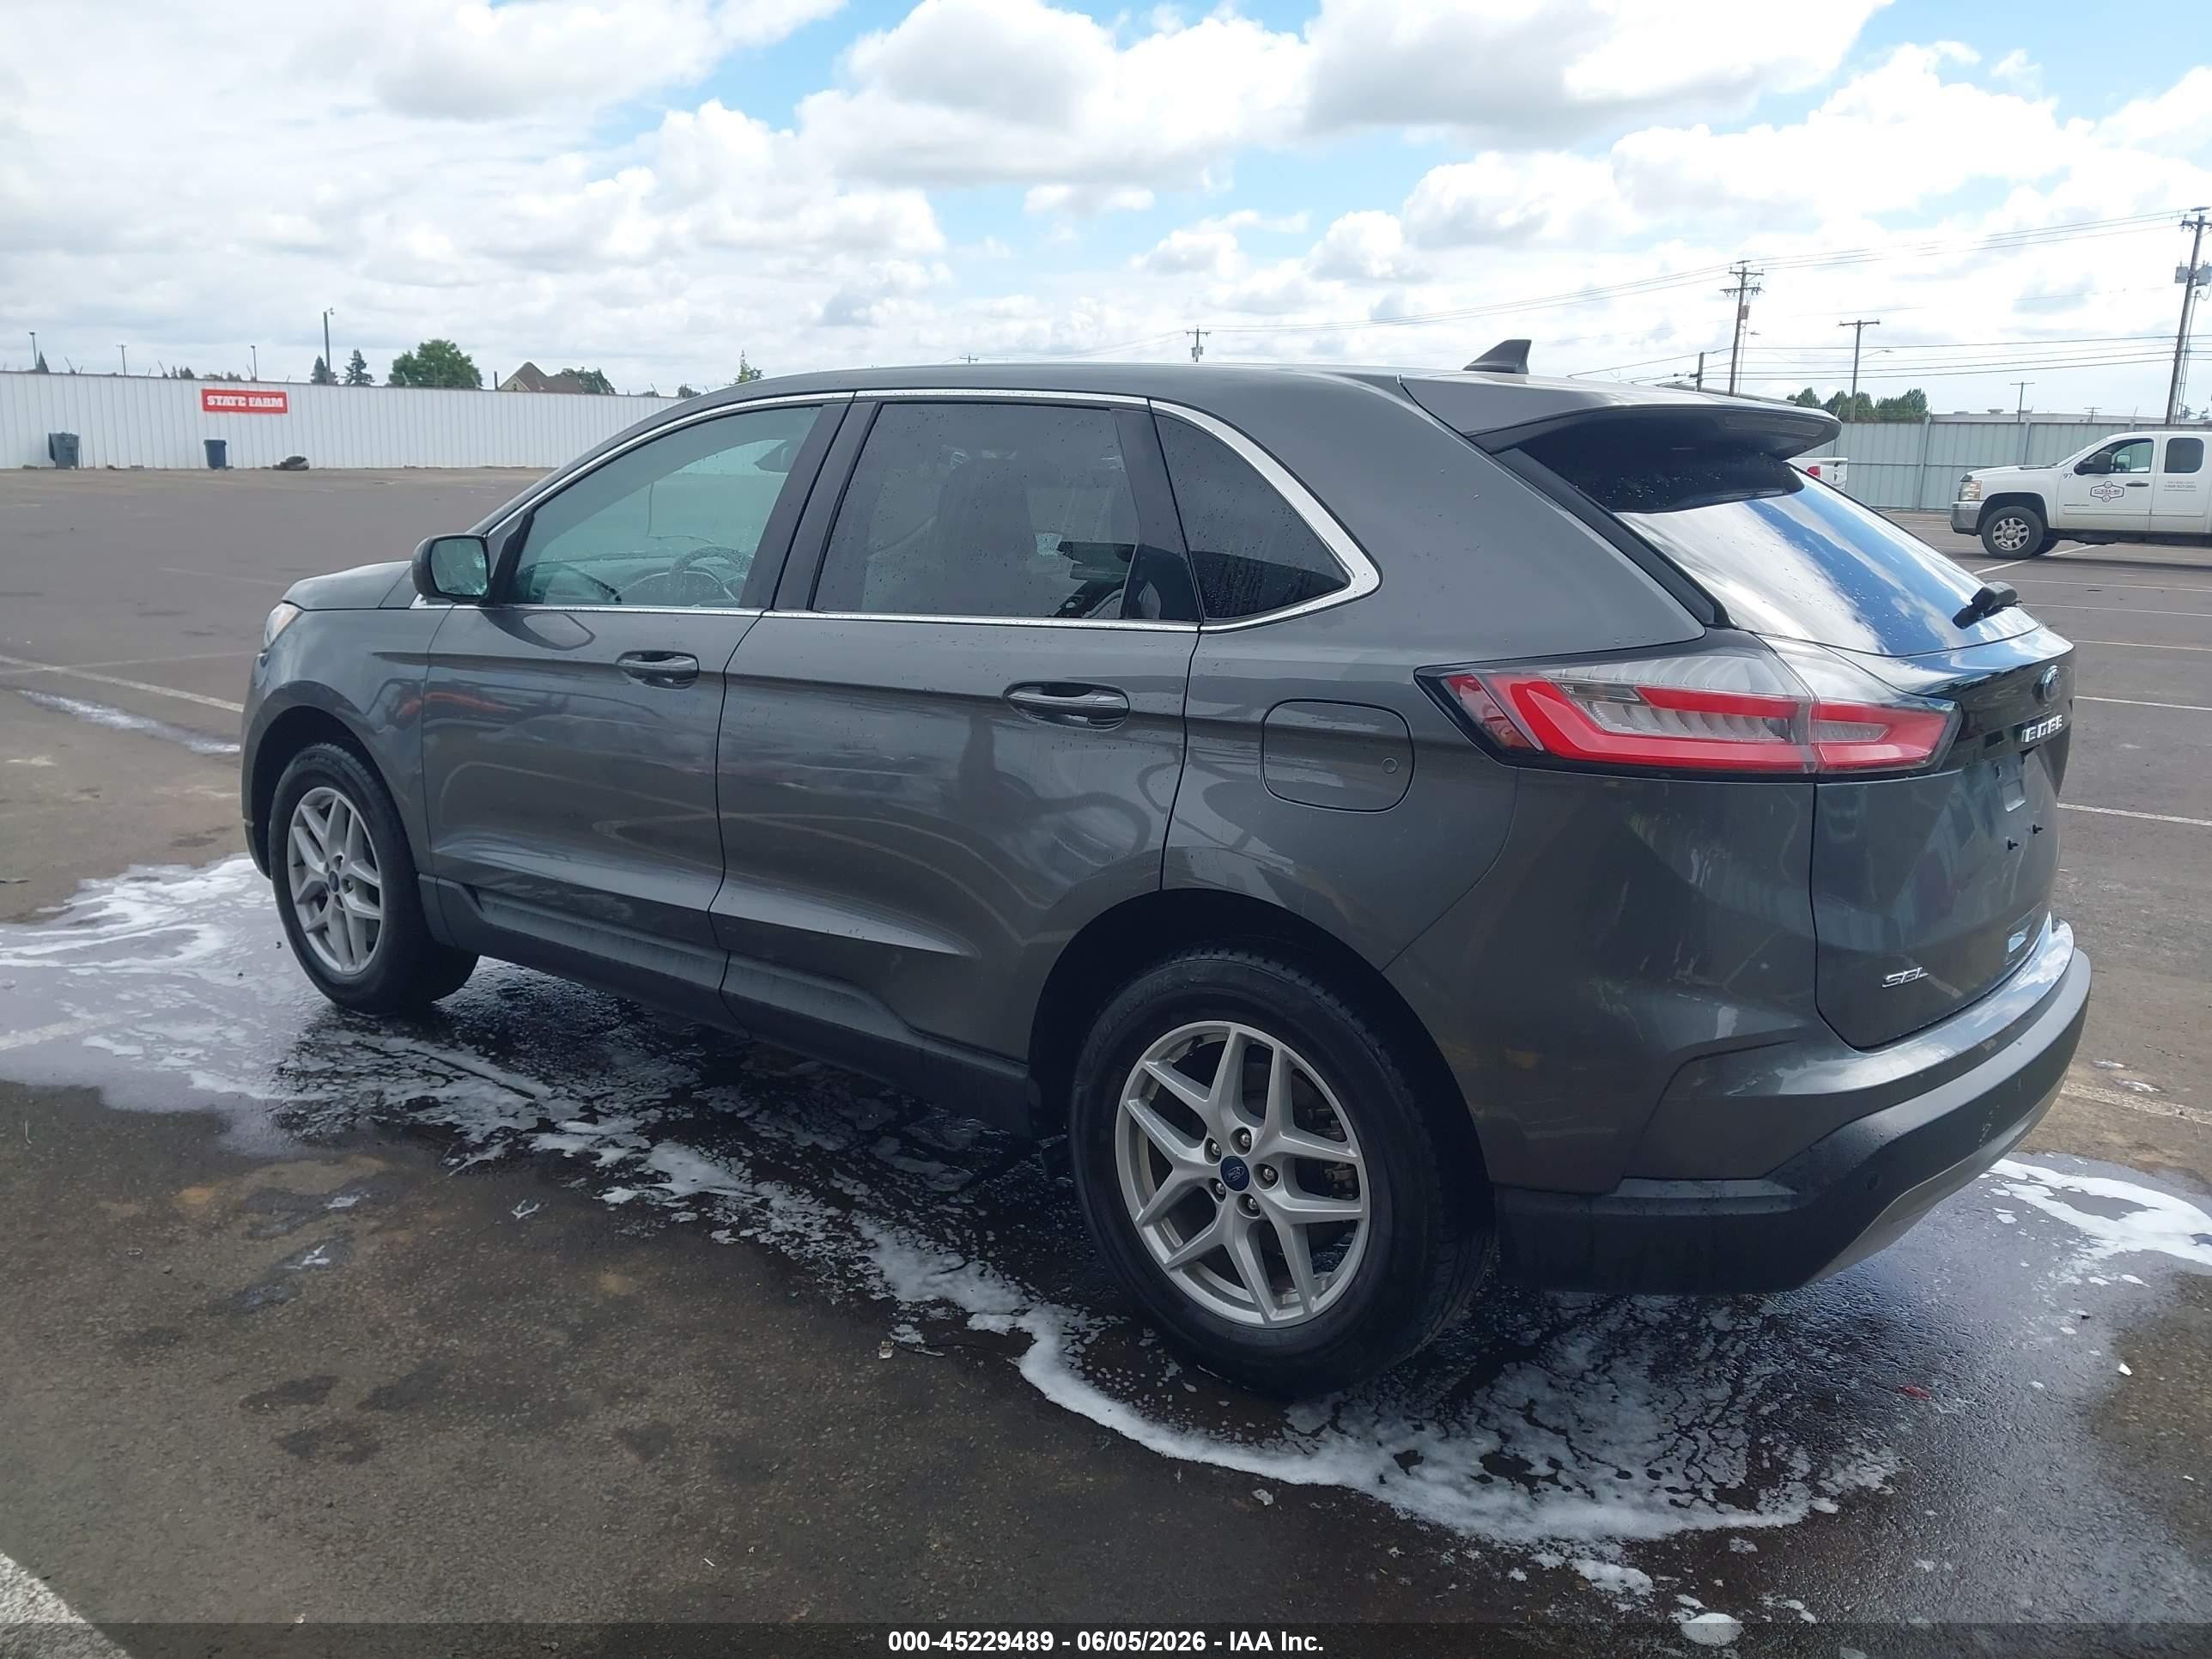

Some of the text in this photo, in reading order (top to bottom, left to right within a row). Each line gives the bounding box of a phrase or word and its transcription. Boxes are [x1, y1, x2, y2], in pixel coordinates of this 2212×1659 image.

[207, 395, 283, 408] STATE FARM
[1881, 966, 1929, 988] SEL
